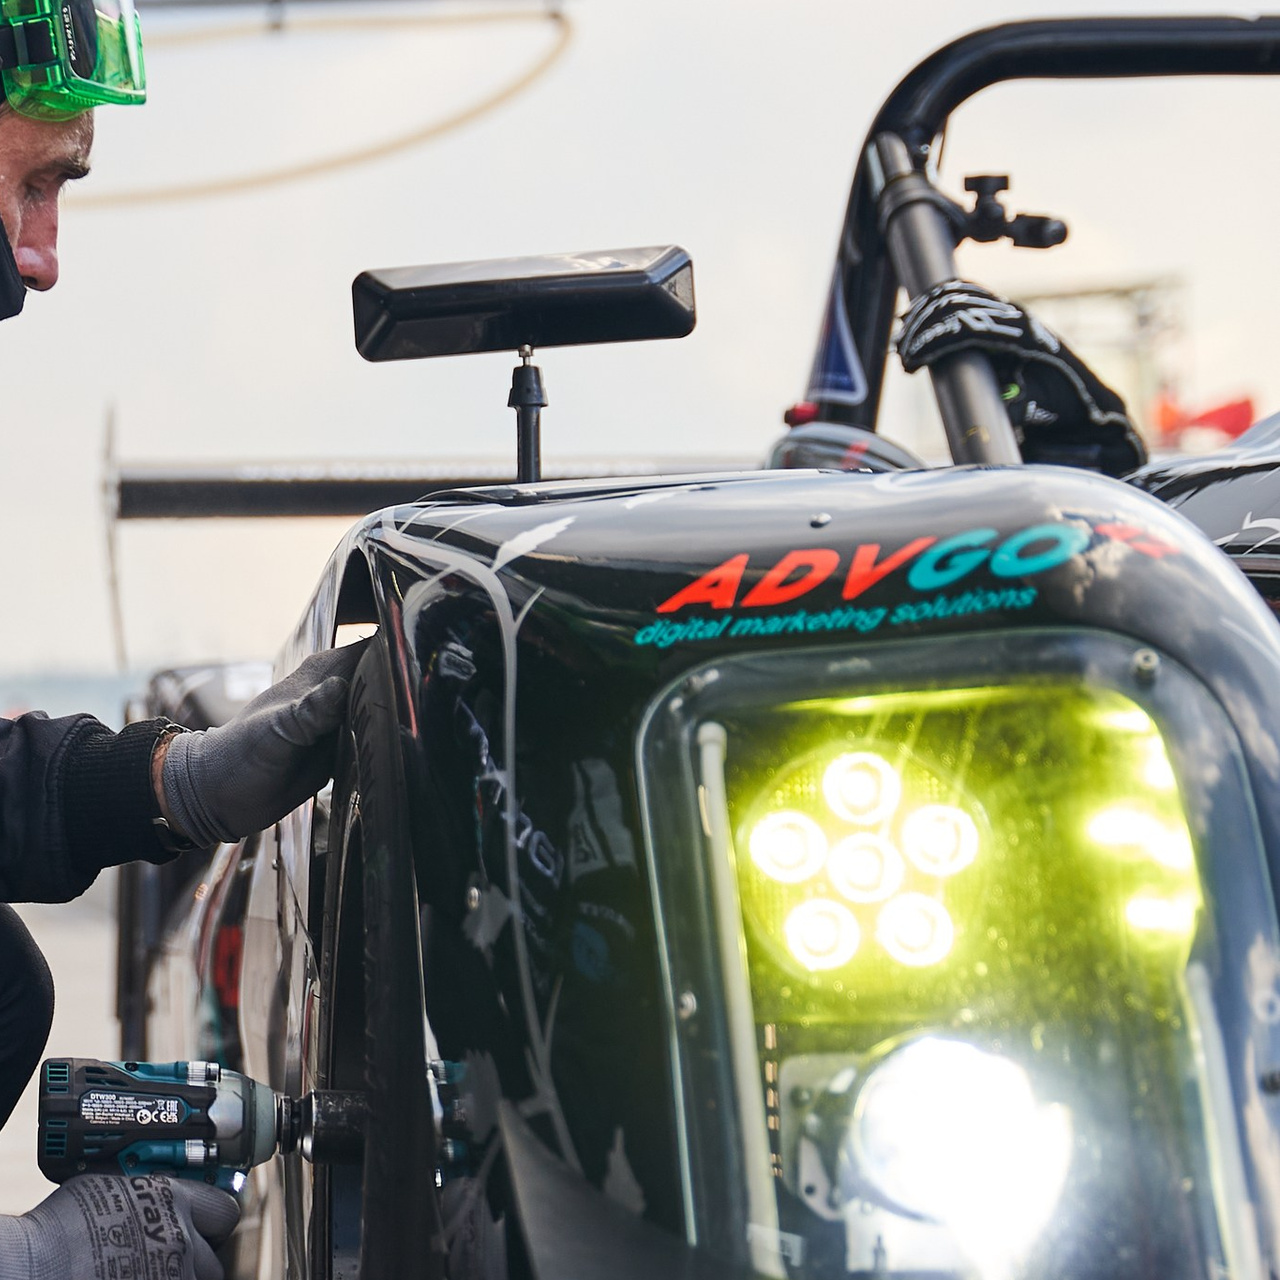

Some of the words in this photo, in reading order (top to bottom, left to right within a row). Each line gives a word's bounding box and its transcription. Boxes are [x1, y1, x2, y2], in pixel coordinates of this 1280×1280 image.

[634, 615, 732, 649] digital
[729, 606, 888, 637] marketing
[890, 587, 1038, 625] solutions
[130, 1176, 168, 1245] Gray
